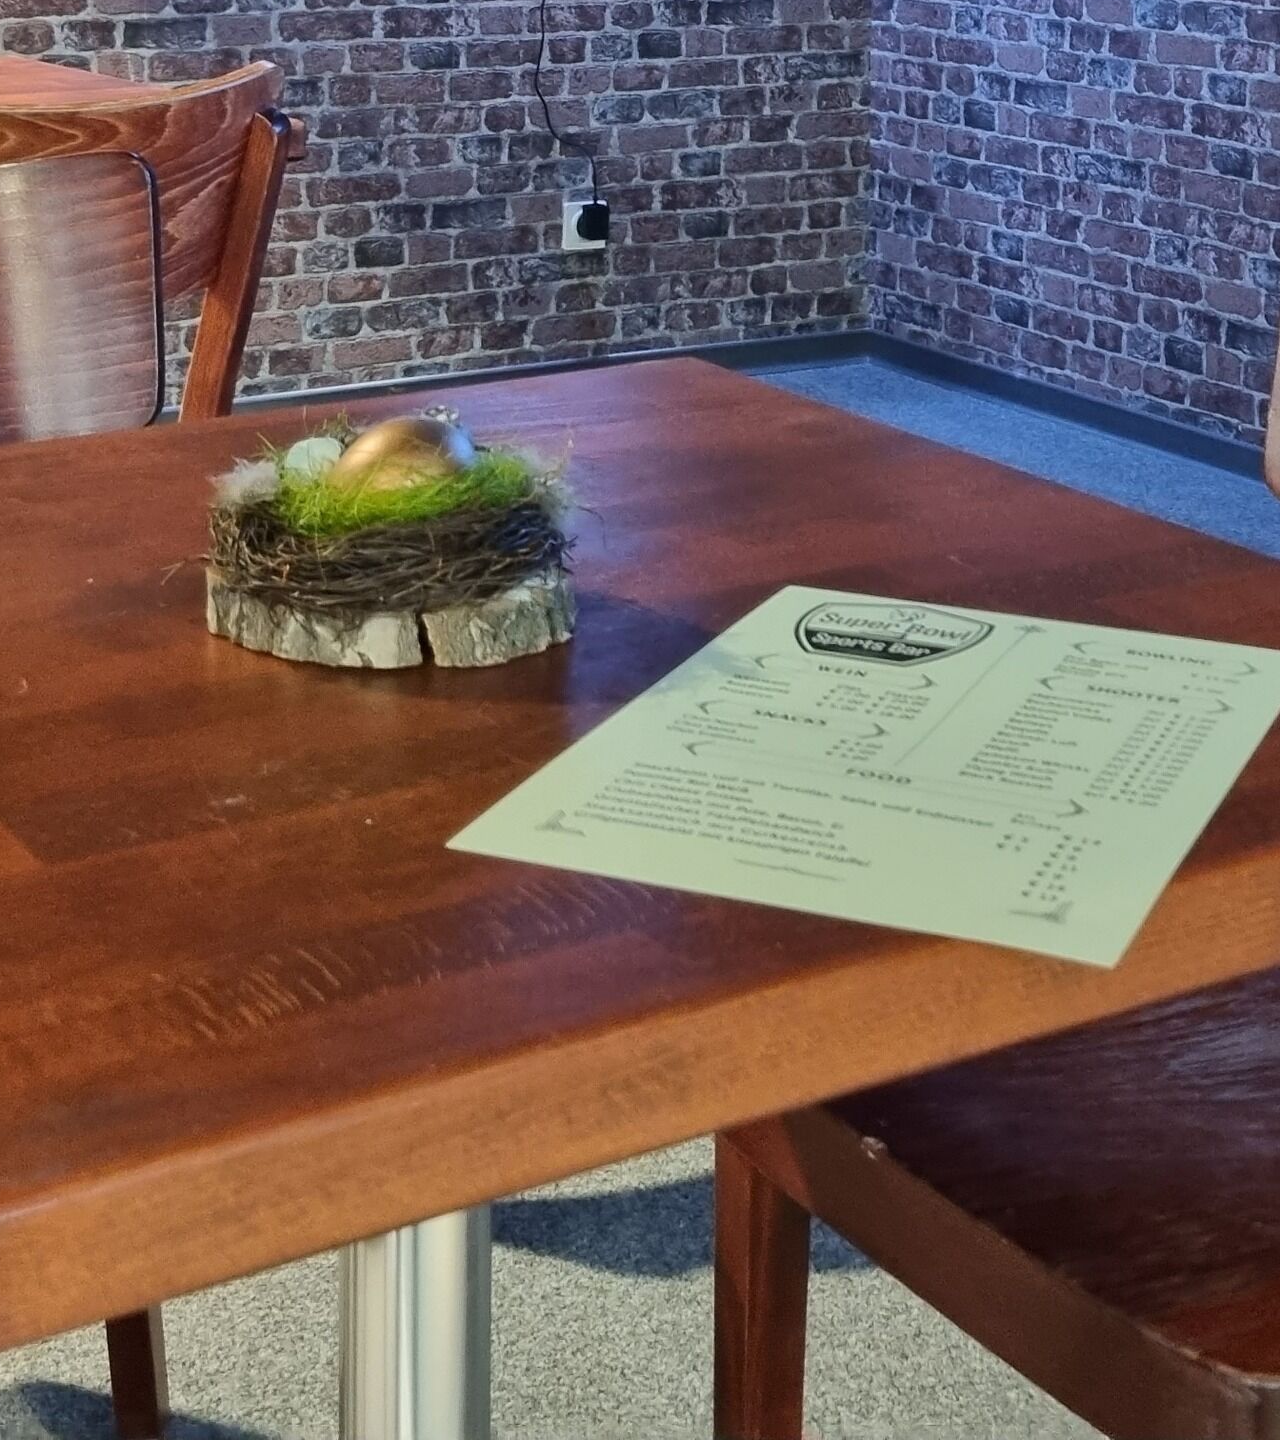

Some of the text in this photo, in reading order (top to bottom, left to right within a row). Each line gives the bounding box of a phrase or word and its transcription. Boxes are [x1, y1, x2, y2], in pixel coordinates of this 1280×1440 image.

[820, 611, 973, 642] Super Bowl
[811, 630, 931, 658] Sports Bar
[818, 665, 868, 678] WEIN
[1087, 684, 1180, 705] SHOOTER
[845, 767, 912, 785] FOOD
